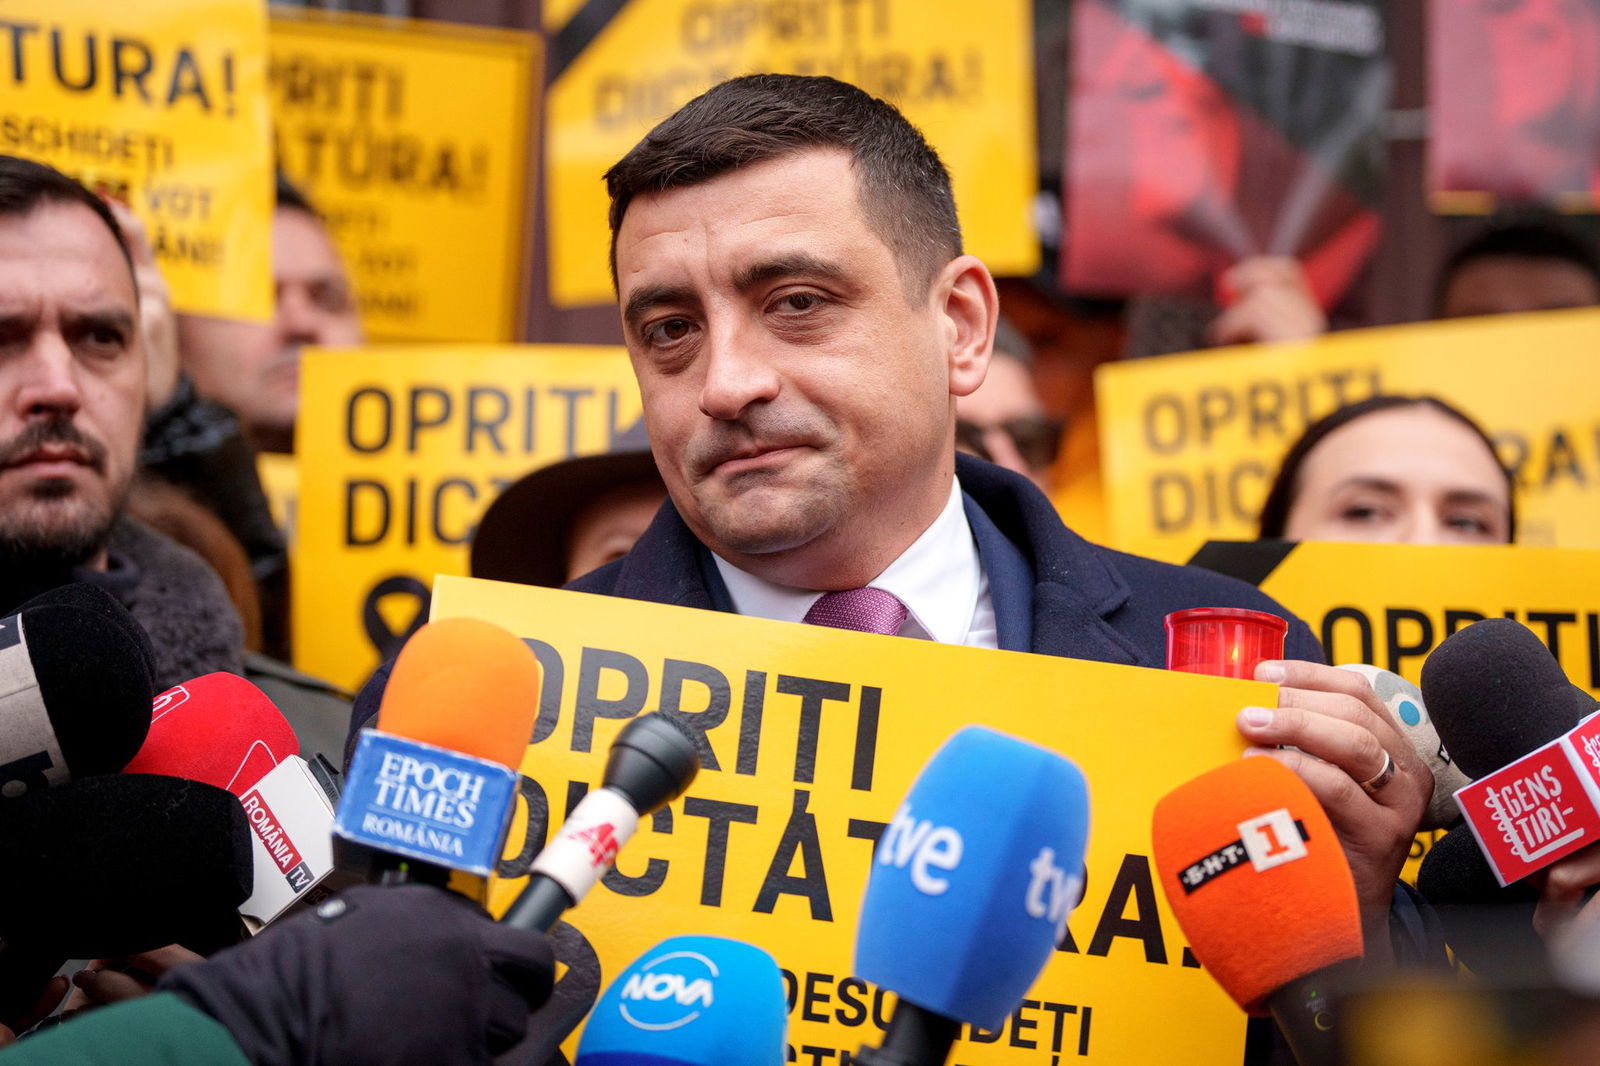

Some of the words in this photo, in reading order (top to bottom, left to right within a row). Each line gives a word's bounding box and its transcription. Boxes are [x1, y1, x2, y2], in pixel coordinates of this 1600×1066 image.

[0, 20, 237, 117] TURA!
[345, 477, 512, 547] DIC
[375, 777, 477, 828] TIMES
[380, 751, 486, 803] EPOCH
[242, 795, 294, 869] ROMÂNIA
[290, 866, 310, 890] TV
[362, 812, 464, 858] ROMÂNIA
[878, 801, 964, 896] tve
[1256, 823, 1290, 857] 1
[1025, 846, 1083, 946] tv
[620, 972, 713, 1008] NOVA
